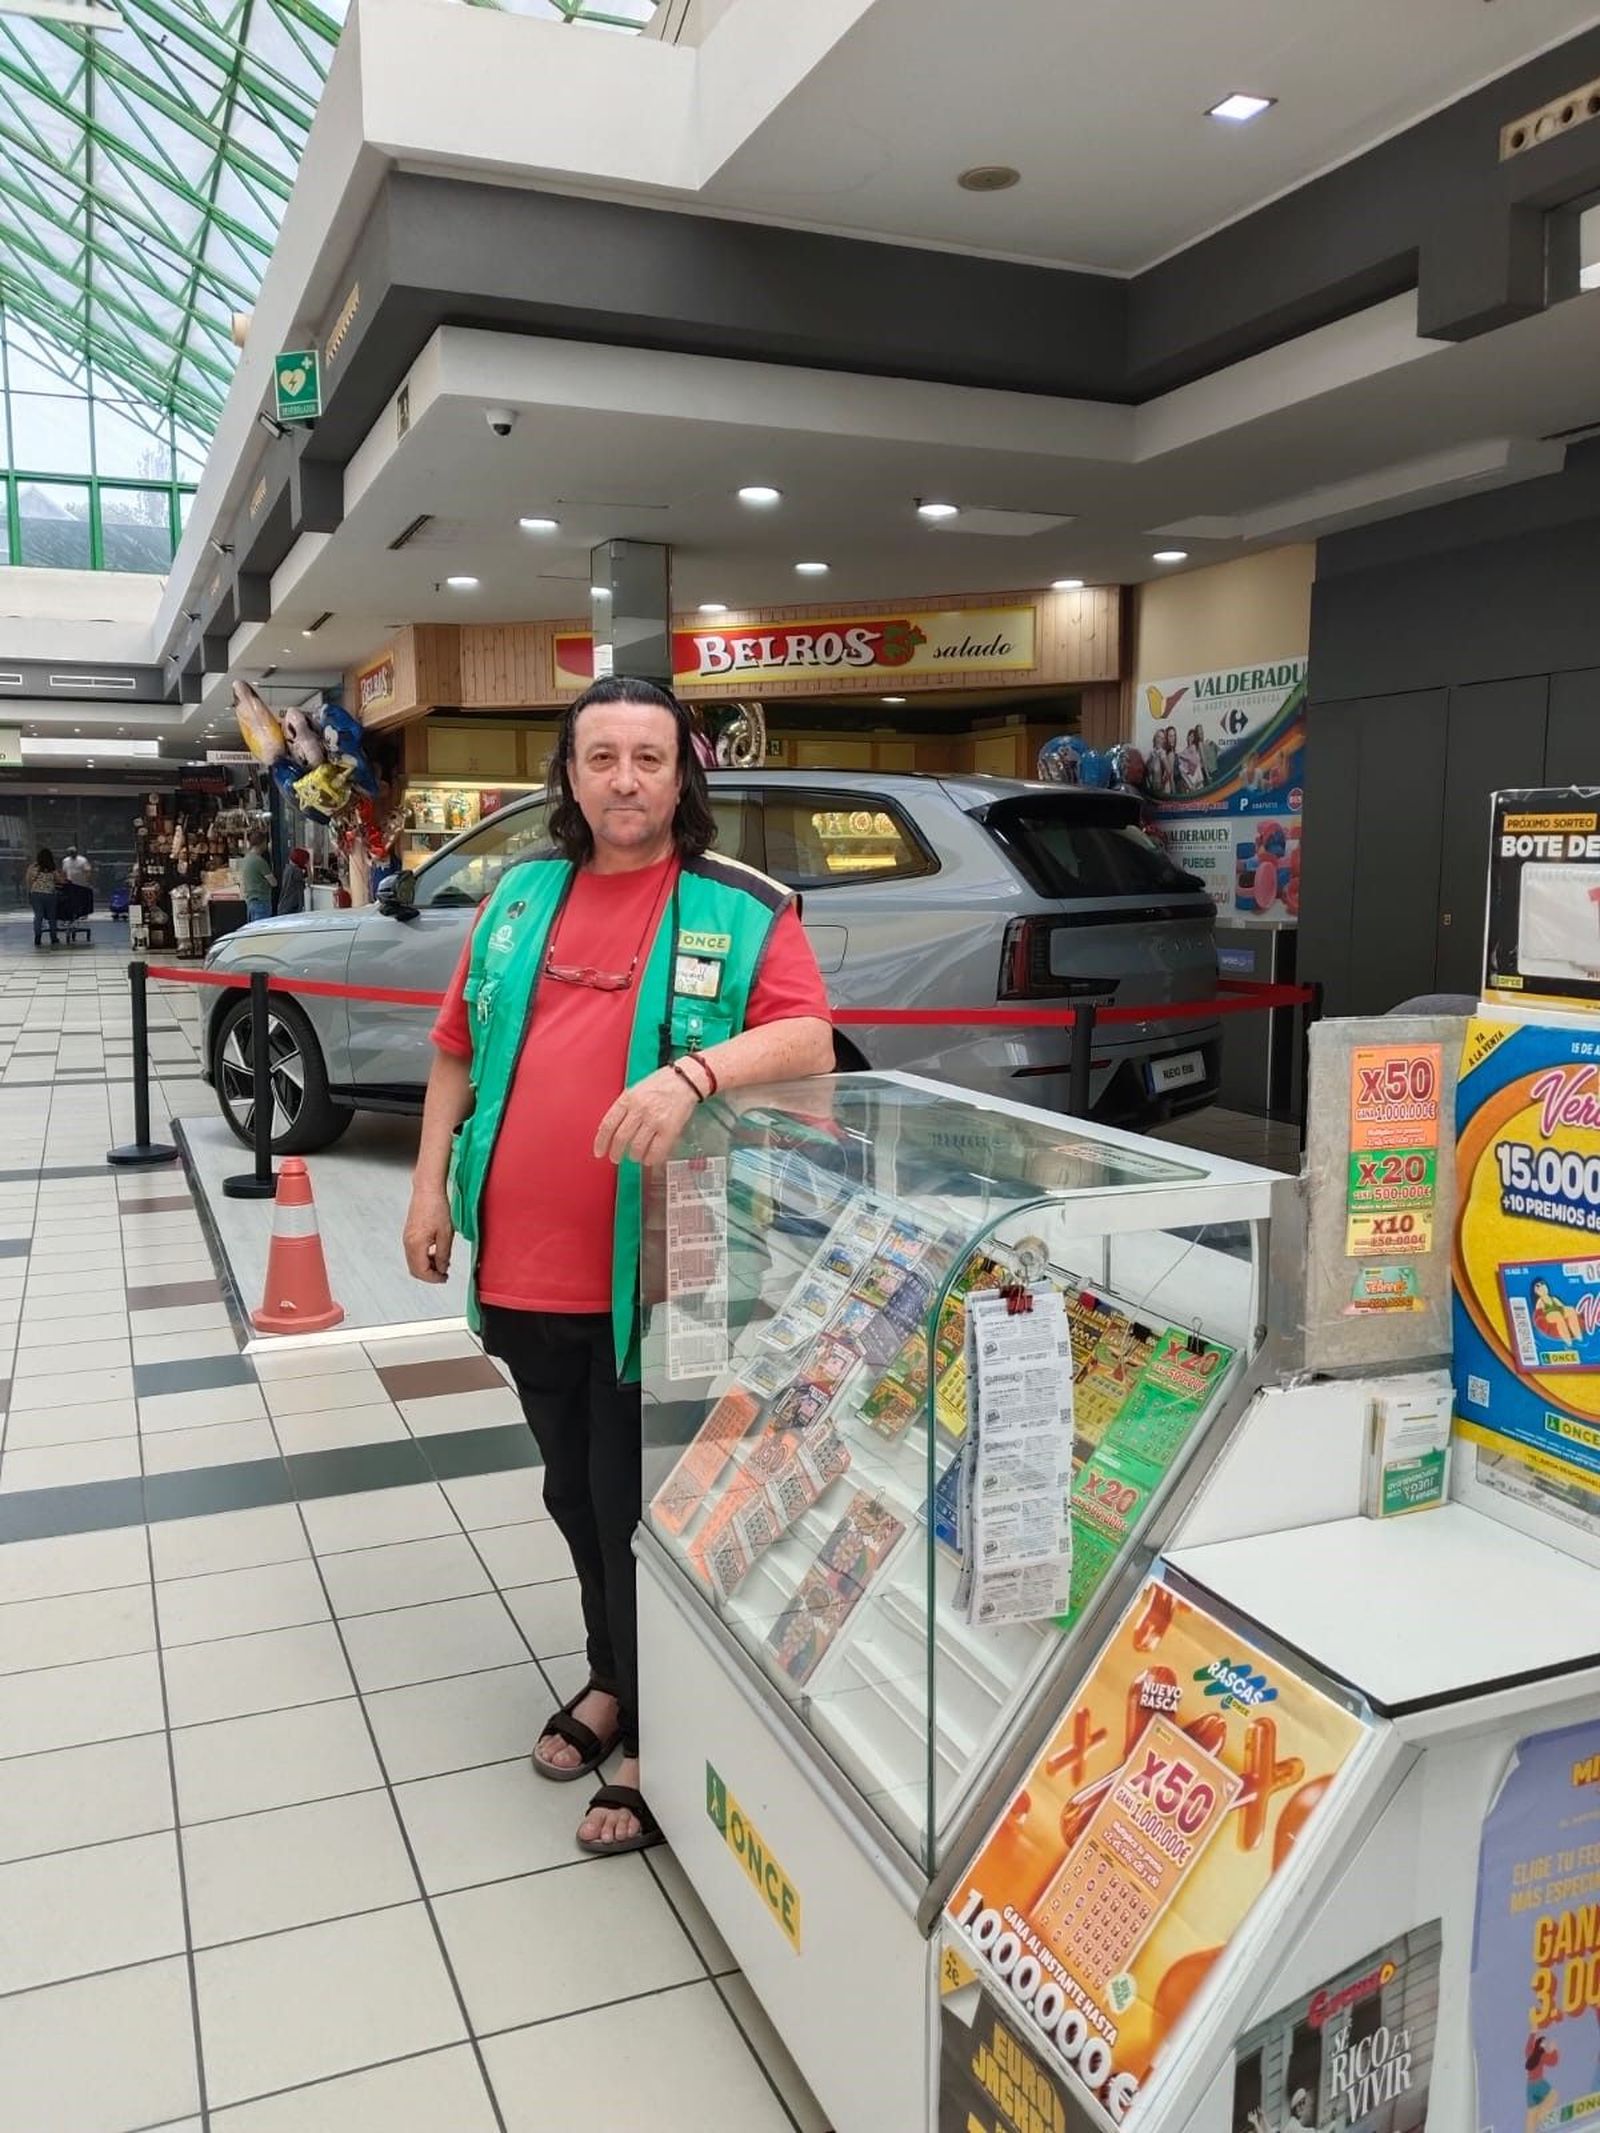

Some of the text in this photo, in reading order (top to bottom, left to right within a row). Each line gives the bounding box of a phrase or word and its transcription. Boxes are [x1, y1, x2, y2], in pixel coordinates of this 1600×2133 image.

[694, 628, 1015, 676] BELROS salado
[1506, 815, 1595, 829] PRÓXIMO SORTEO
[1501, 834, 1600, 858] BOTE DE
[683, 935, 727, 949] ONCE
[1467, 1030, 1505, 1068] A LA VENTA
[1475, 1031, 1486, 1044] YA
[1580, 1042, 1593, 1055] DE
[1502, 1195, 1525, 1213] +10
[1526, 1199, 1585, 1227] PREMIOS
[1372, 1214, 1415, 1234] x10
[1551, 1353, 1576, 1362] ONCE
[1563, 1425, 1600, 1444] ONCE
[1141, 1681, 1183, 1699] NUEVO
[1207, 1661, 1264, 1705] RASCAS
[1140, 1695, 1178, 1712] RASCA
[1130, 1802, 1192, 1868] 1.000.000€
[1556, 1848, 1575, 1873] TU
[730, 1809, 797, 1938] ONCE
[1003, 1904, 1118, 2047] GANA AL INSTANTE HASTA
[1331, 2026, 1390, 2100] RICO
[1346, 2053, 1413, 2124] VIVIR
